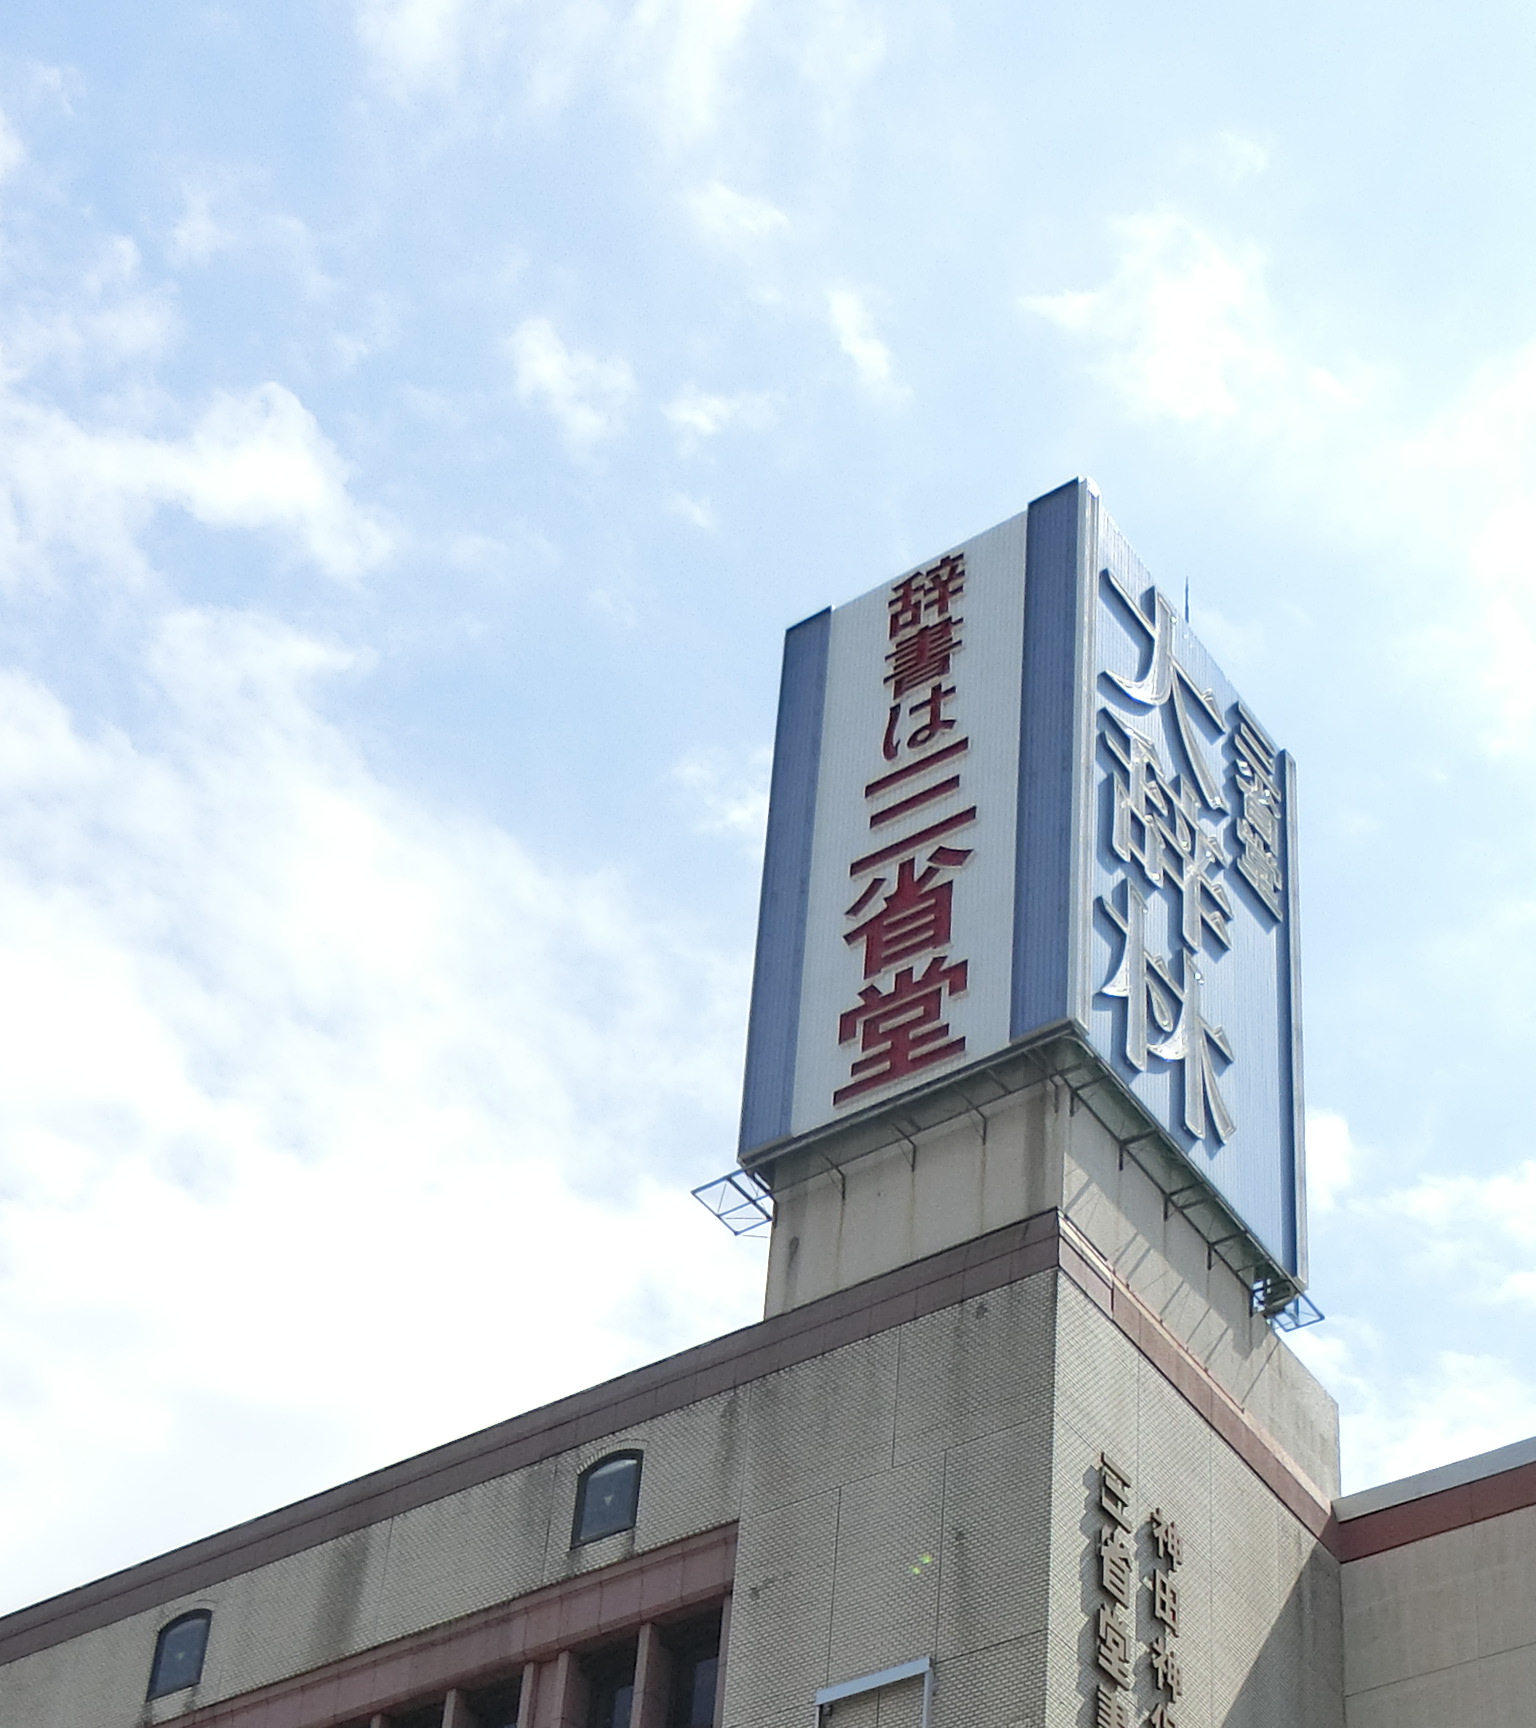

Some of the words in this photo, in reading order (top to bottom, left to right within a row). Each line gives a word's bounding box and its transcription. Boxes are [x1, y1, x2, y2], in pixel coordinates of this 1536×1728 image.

[832, 552, 976, 1106] 辞書は三省堂
[1097, 568, 1236, 1143] 大辞林
[1233, 701, 1283, 922] 三省堂
